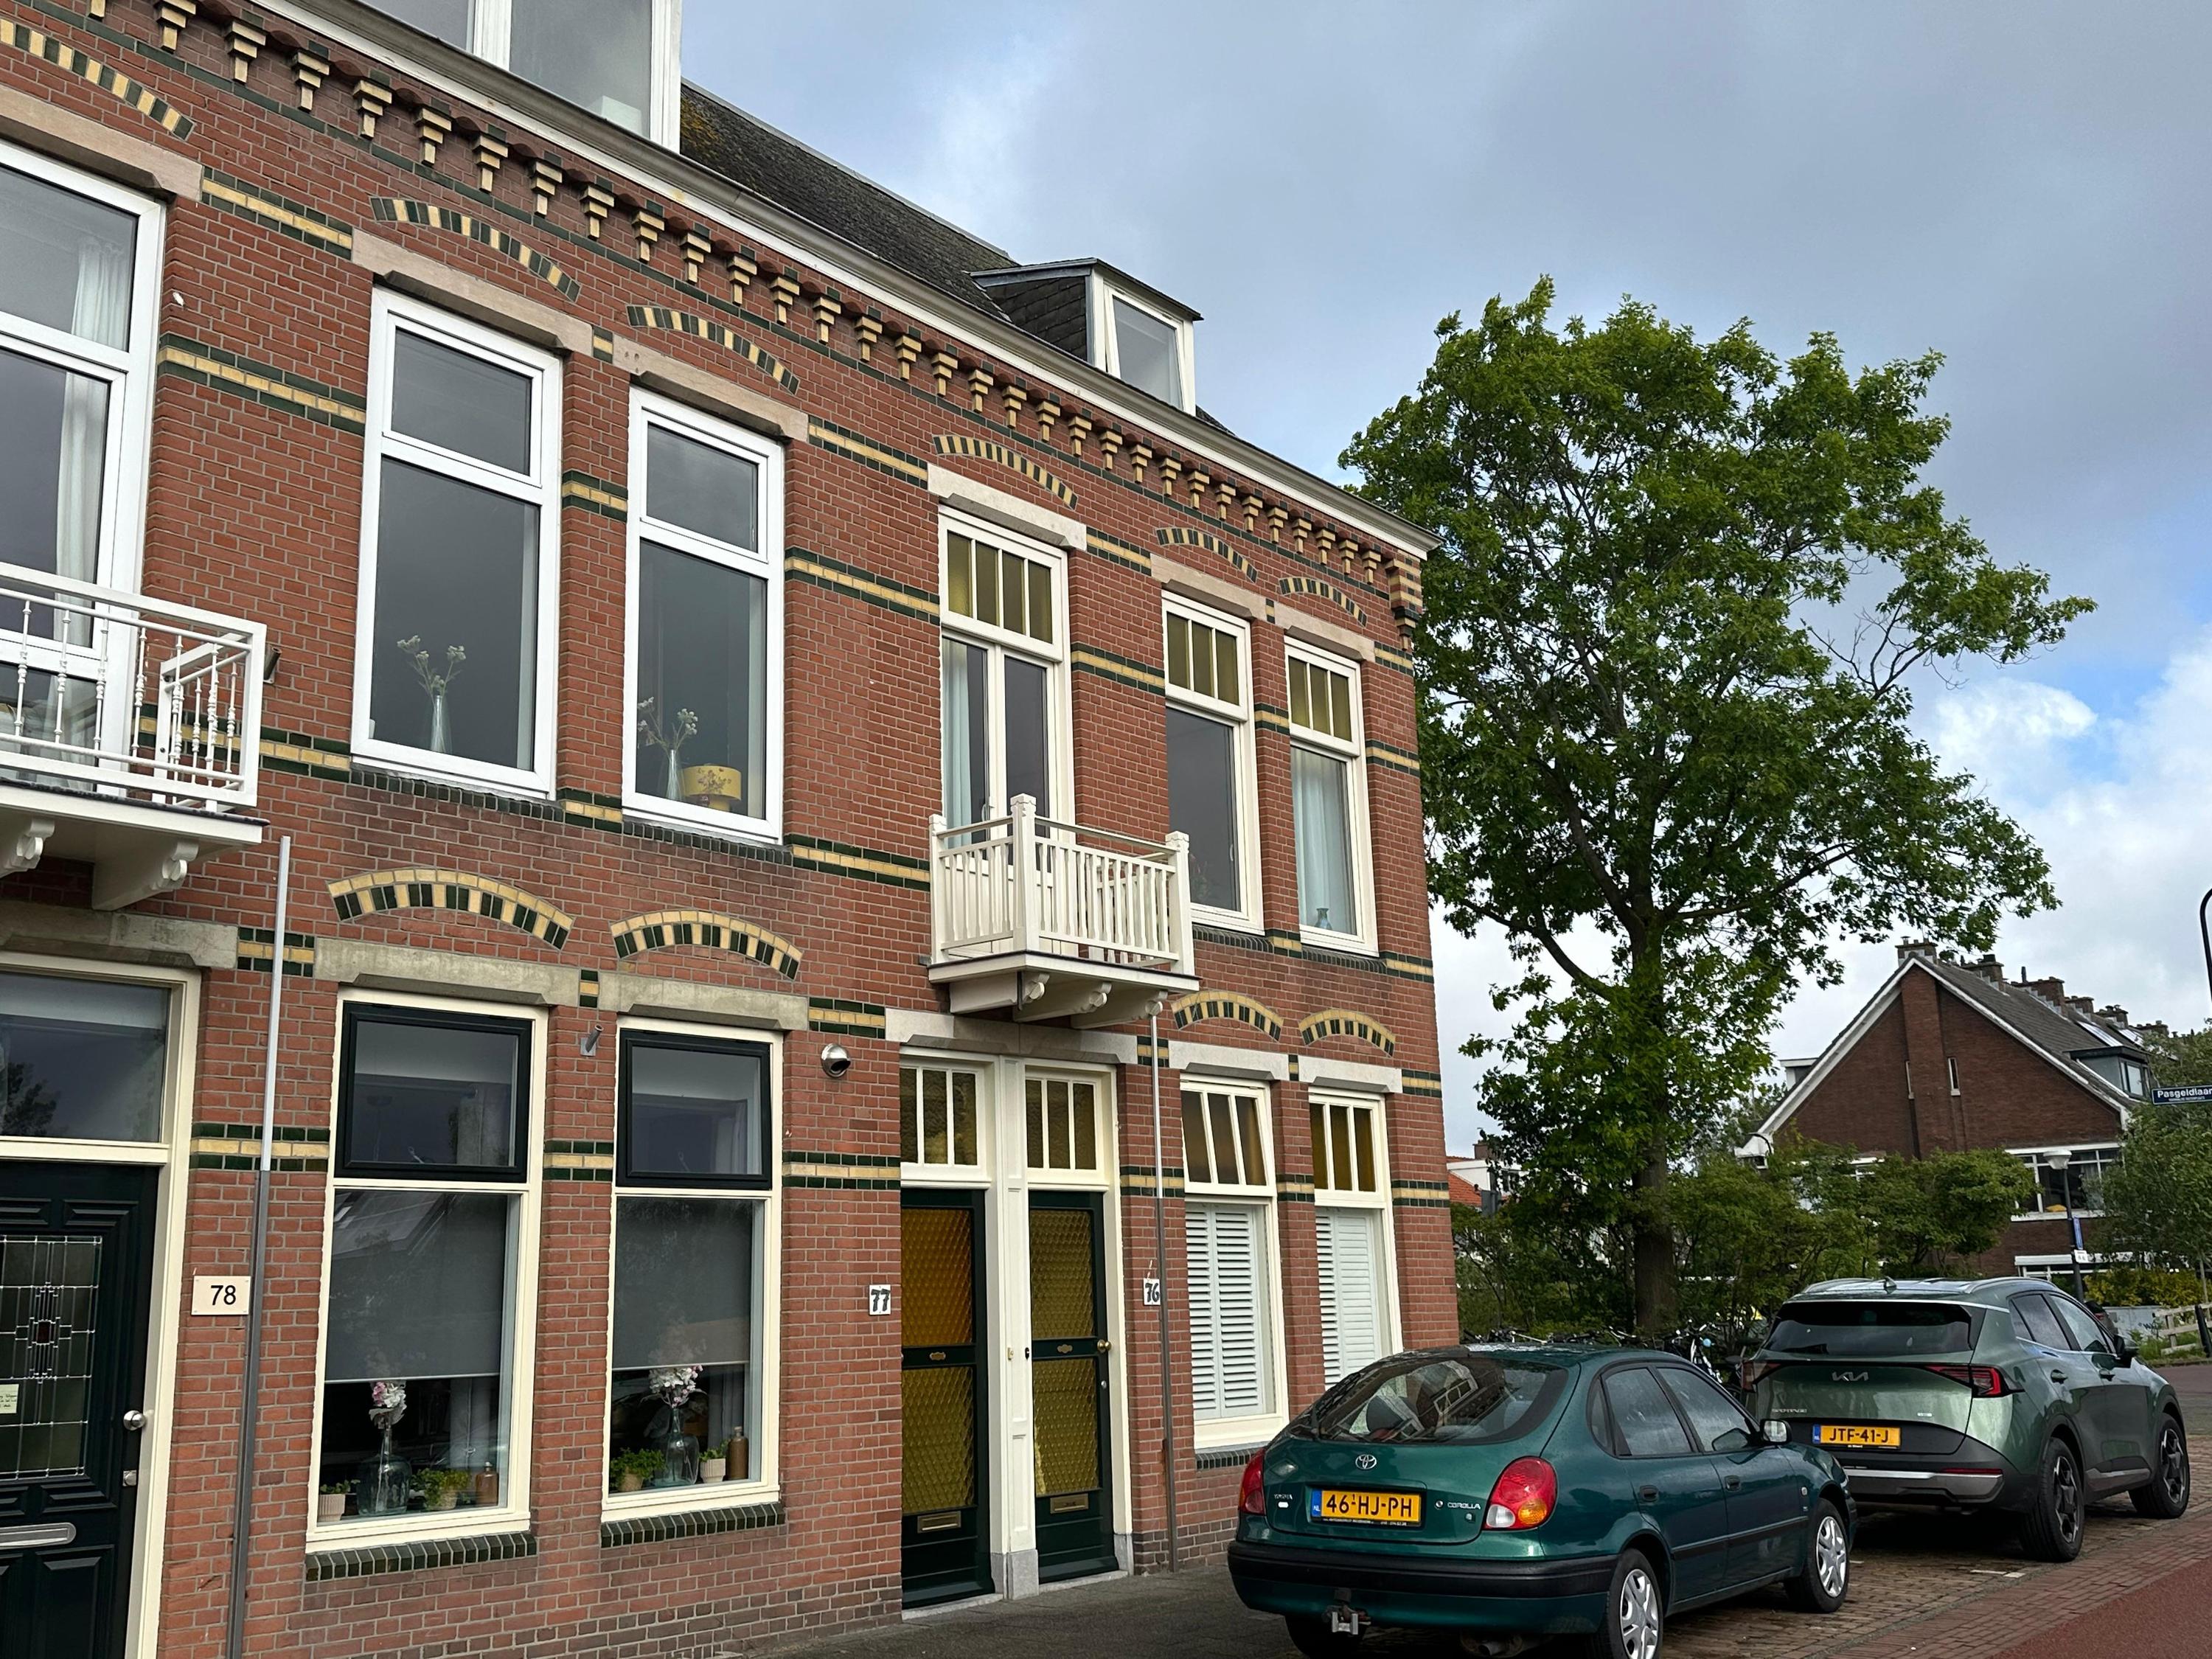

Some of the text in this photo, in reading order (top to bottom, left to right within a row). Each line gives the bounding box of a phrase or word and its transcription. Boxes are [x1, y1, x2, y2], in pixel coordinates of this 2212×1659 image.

[211, 1285, 236, 1305] 78
[871, 1288, 890, 1312] 77
[1145, 1283, 1159, 1302] 76
[1829, 1428, 1889, 1442] JTF-41-J
[1326, 1494, 1412, 1517] 46-HJ-PH
